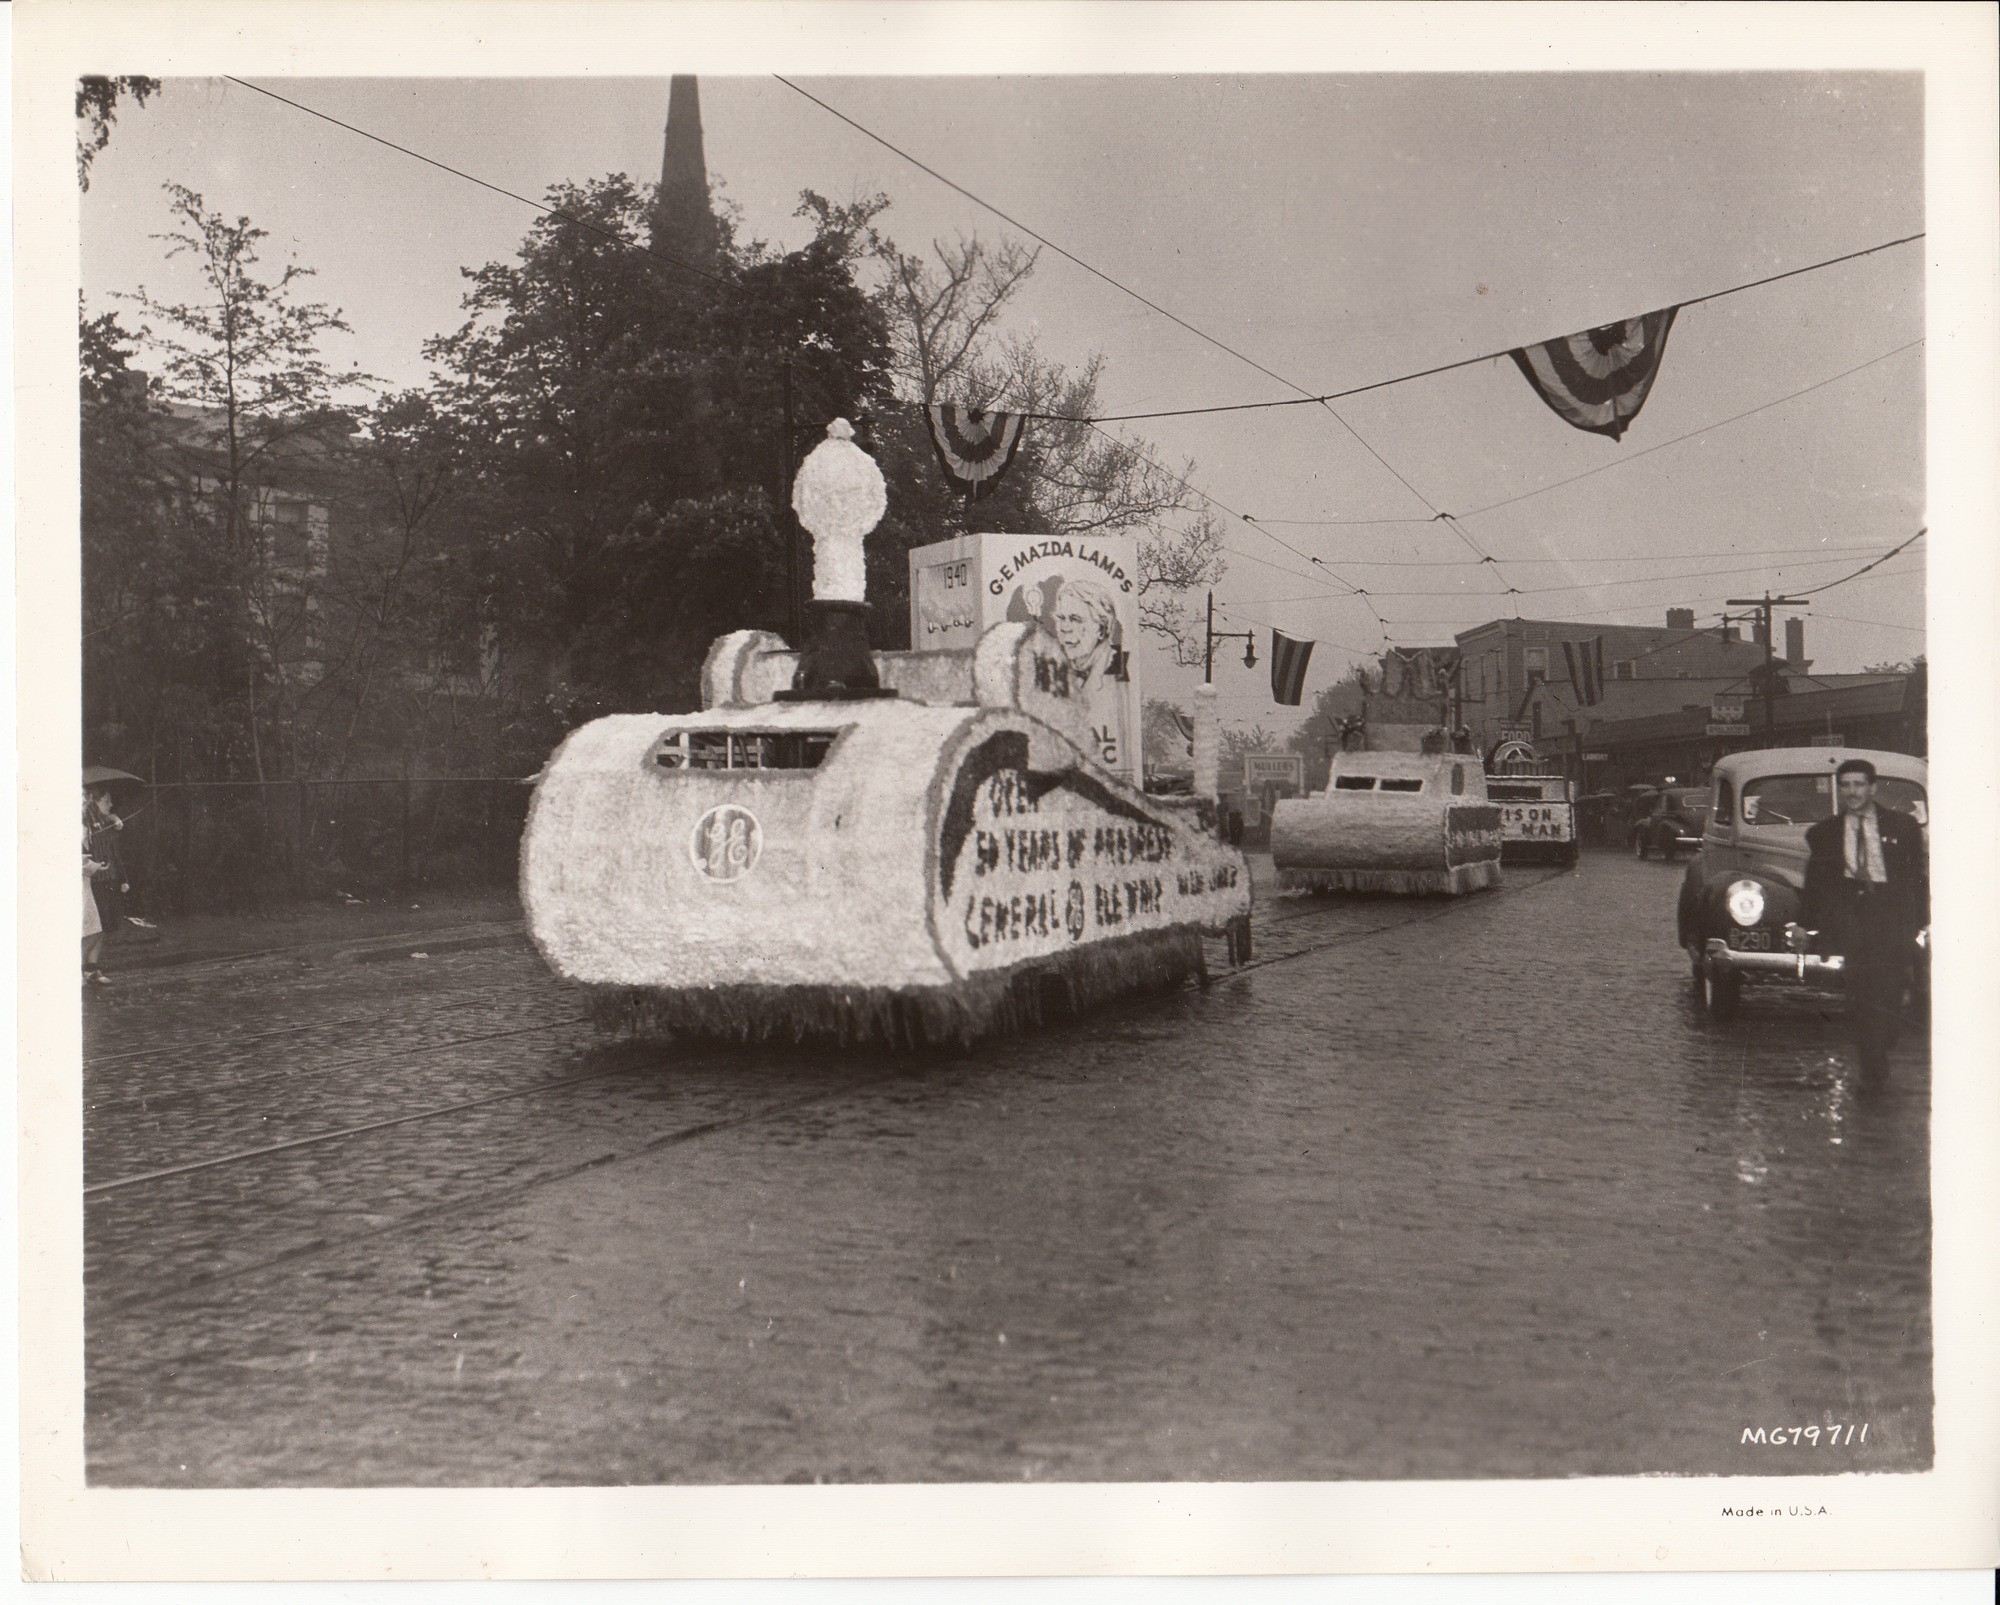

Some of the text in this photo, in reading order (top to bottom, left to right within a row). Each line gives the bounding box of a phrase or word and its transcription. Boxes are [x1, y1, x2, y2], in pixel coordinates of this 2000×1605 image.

[989, 541, 1134, 595] G-E MAZDA LAMPS
[944, 564, 967, 589] 1940
[1501, 808, 1552, 821] ISON
[1521, 823, 1562, 836] MAN
[1721, 1506, 1833, 1517] Made in U.S.A.
